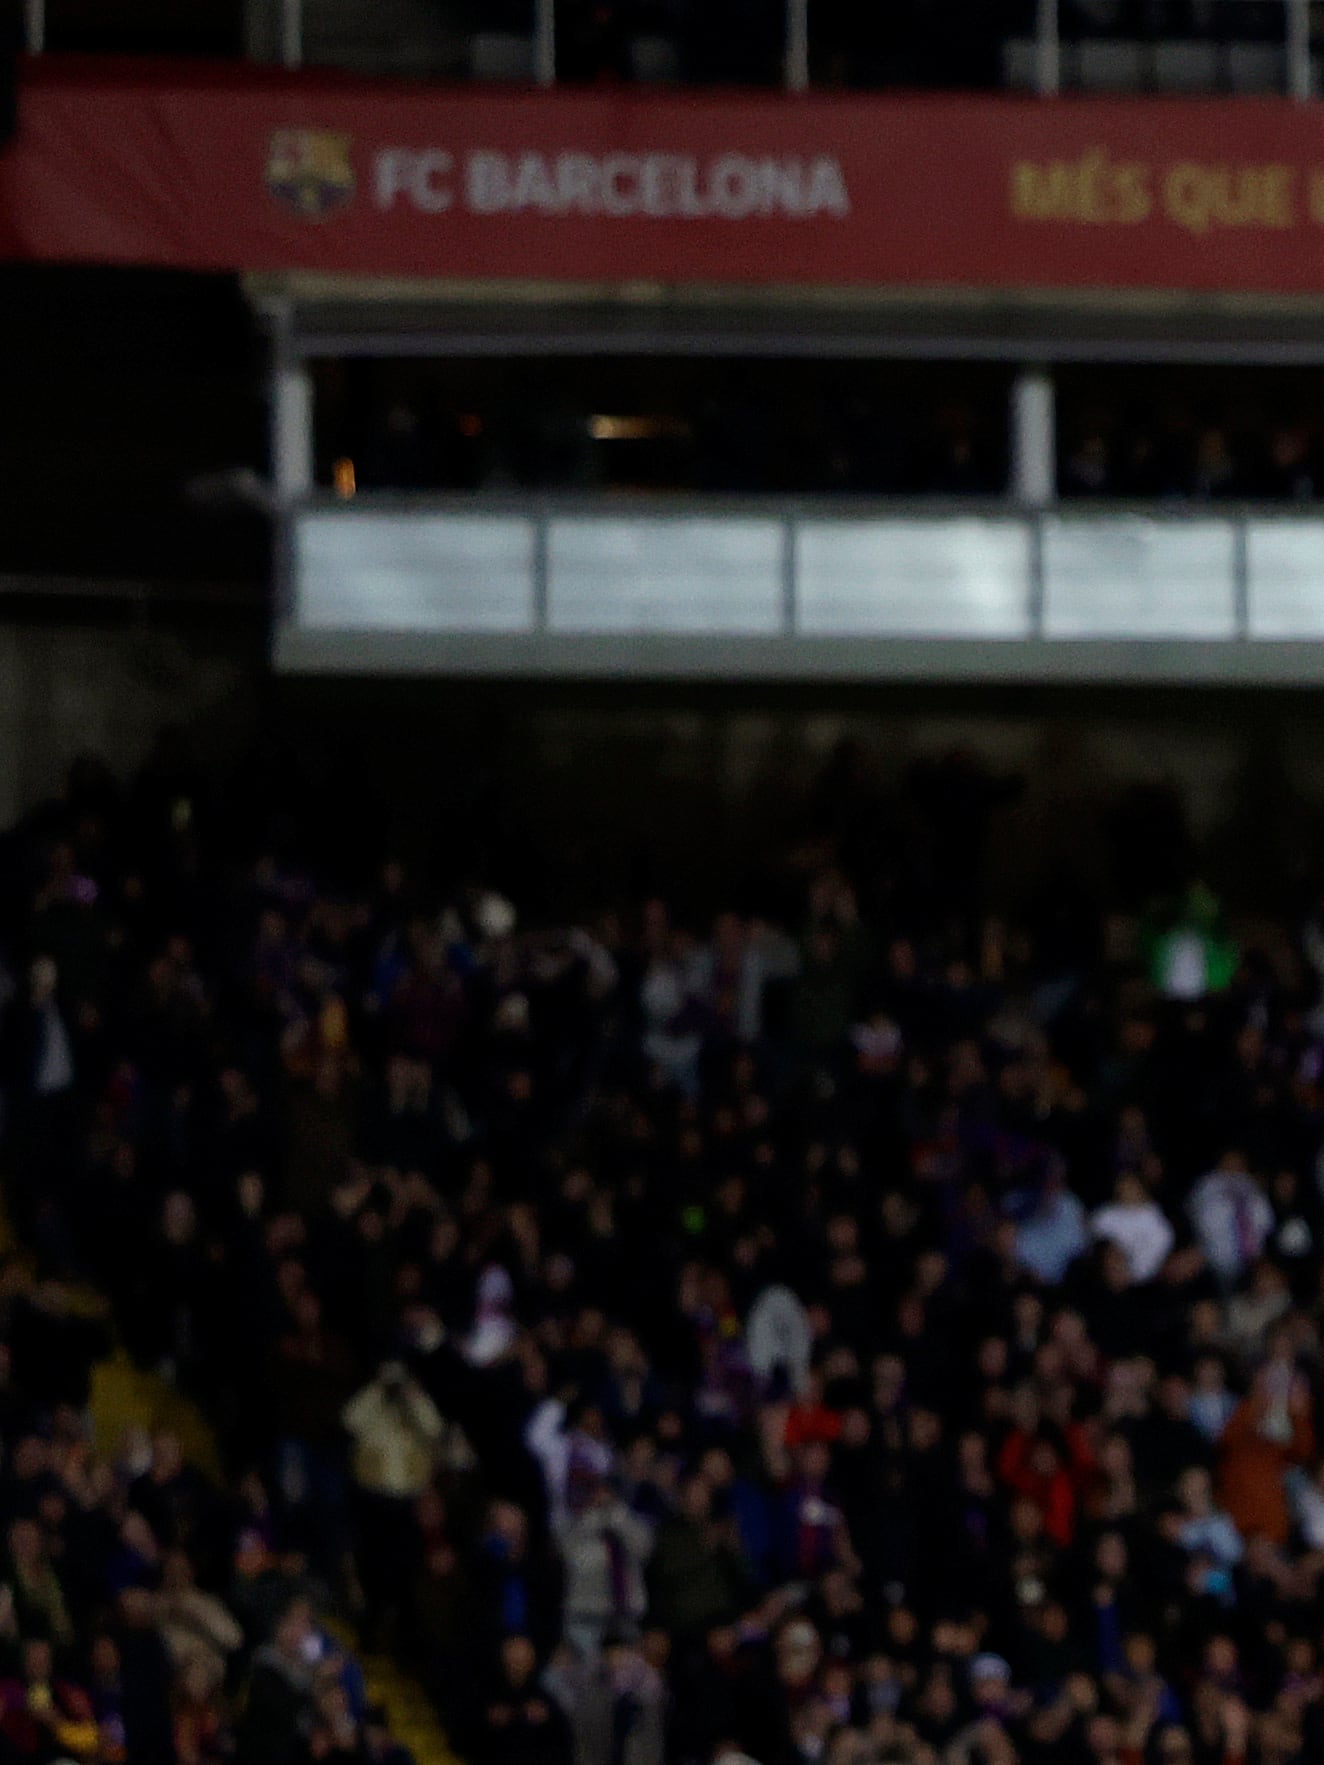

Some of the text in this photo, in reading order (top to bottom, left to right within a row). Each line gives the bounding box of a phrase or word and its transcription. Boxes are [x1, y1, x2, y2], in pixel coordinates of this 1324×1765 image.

[374, 147, 851, 218] FC BARCELONA
[1010, 148, 1151, 225] MÉS
[1164, 163, 1296, 233] QUE
